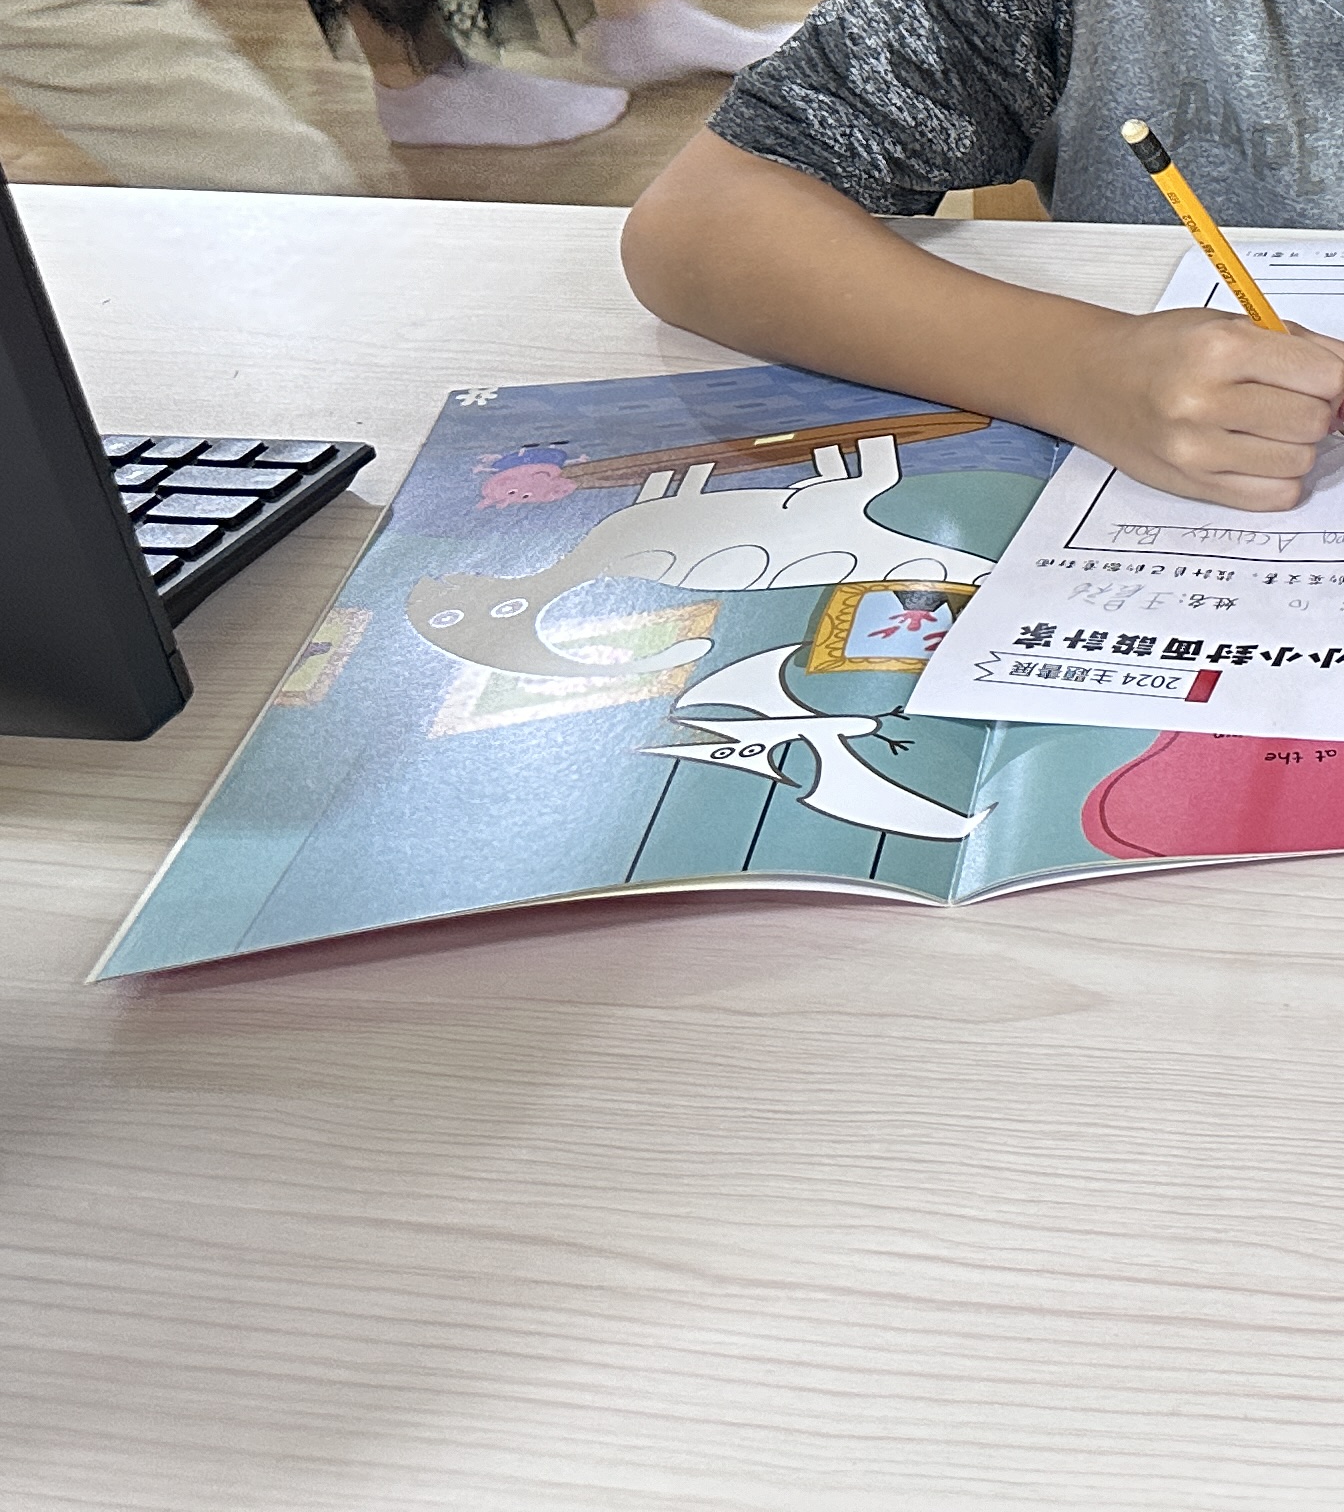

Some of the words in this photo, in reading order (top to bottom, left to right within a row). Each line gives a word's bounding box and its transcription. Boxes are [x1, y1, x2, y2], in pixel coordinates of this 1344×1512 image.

[1215, 261, 1237, 286] LEAD
[1181, 522, 1300, 555] Activity
[1008, 659, 1118, 685] 主題書展
[1121, 672, 1182, 691] 2024
[1263, 751, 1304, 765] the
[1314, 748, 1338, 763] at
